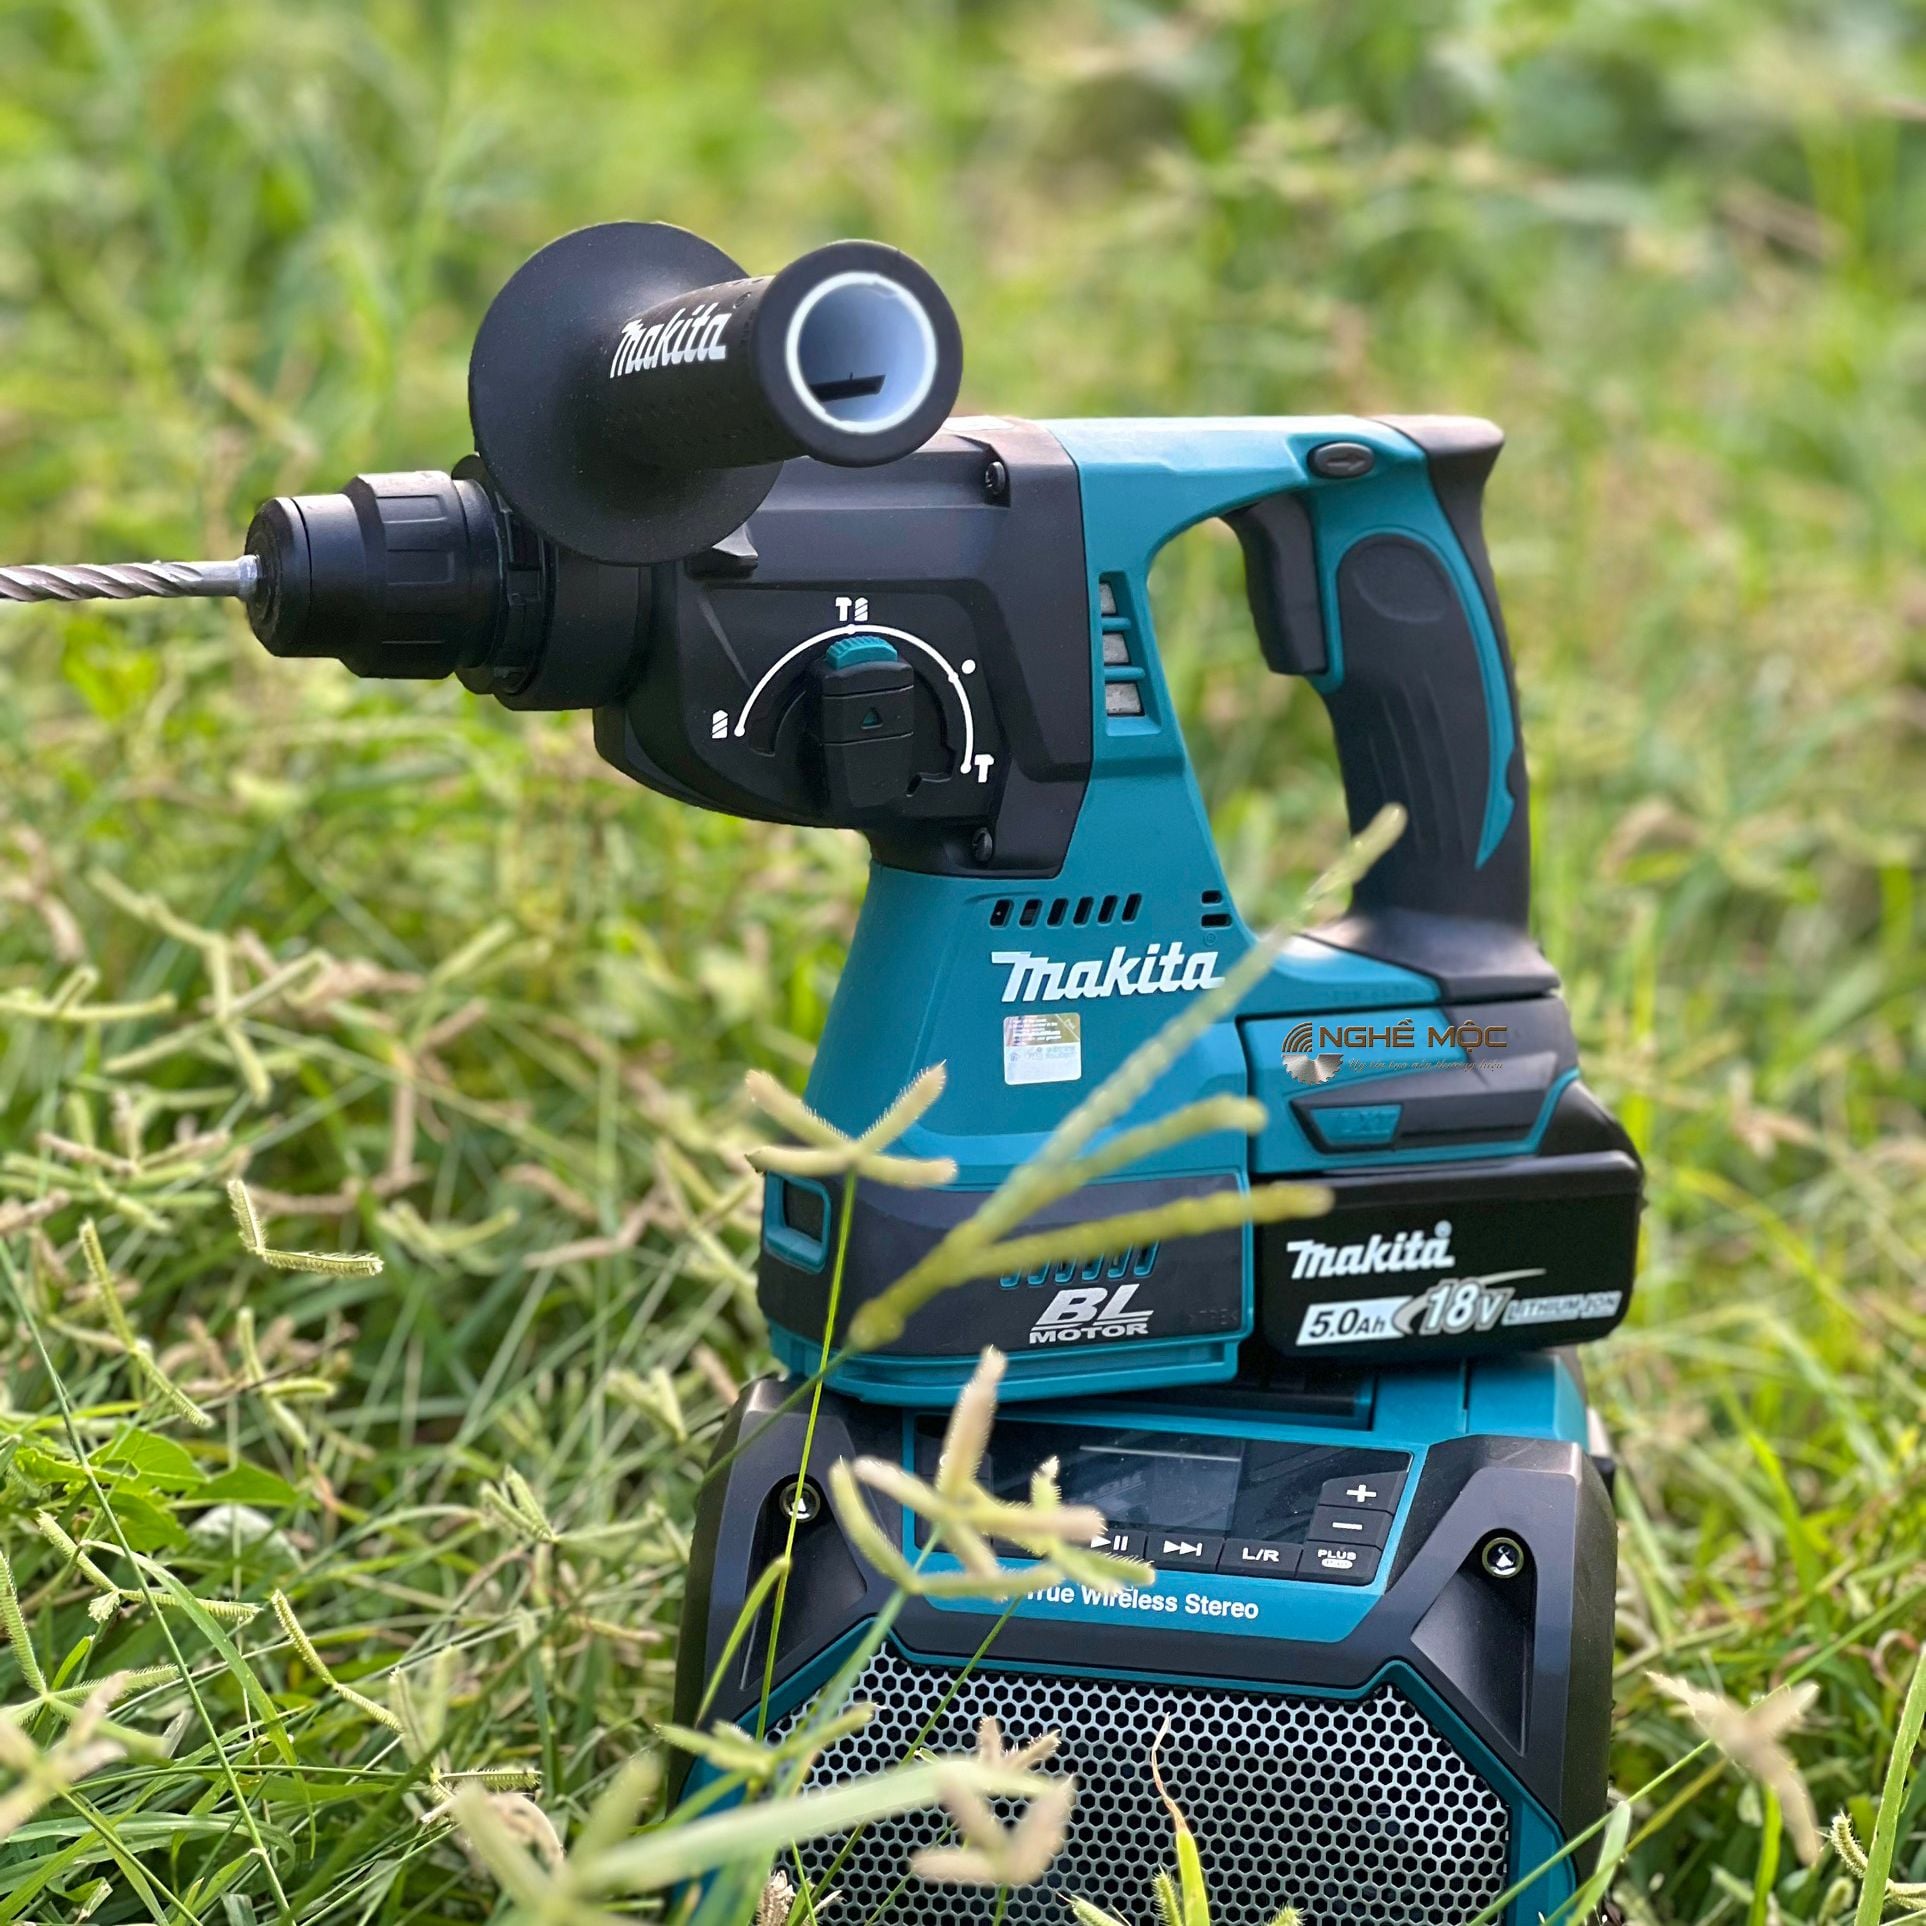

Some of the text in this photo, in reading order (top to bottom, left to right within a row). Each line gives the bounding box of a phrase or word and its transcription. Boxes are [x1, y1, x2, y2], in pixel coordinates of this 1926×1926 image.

[1032, 1283, 1154, 1329] BL
[1308, 1308, 1386, 1338] 5.0Ah
[1421, 1278, 1514, 1334] 18V
[1029, 1322, 1149, 1344] MOTOR
[1242, 1547, 1279, 1562] L/R
[1317, 1549, 1357, 1561] PLUS
[1080, 1583, 1178, 1612] Wireless
[1185, 1596, 1259, 1619] Stereo
